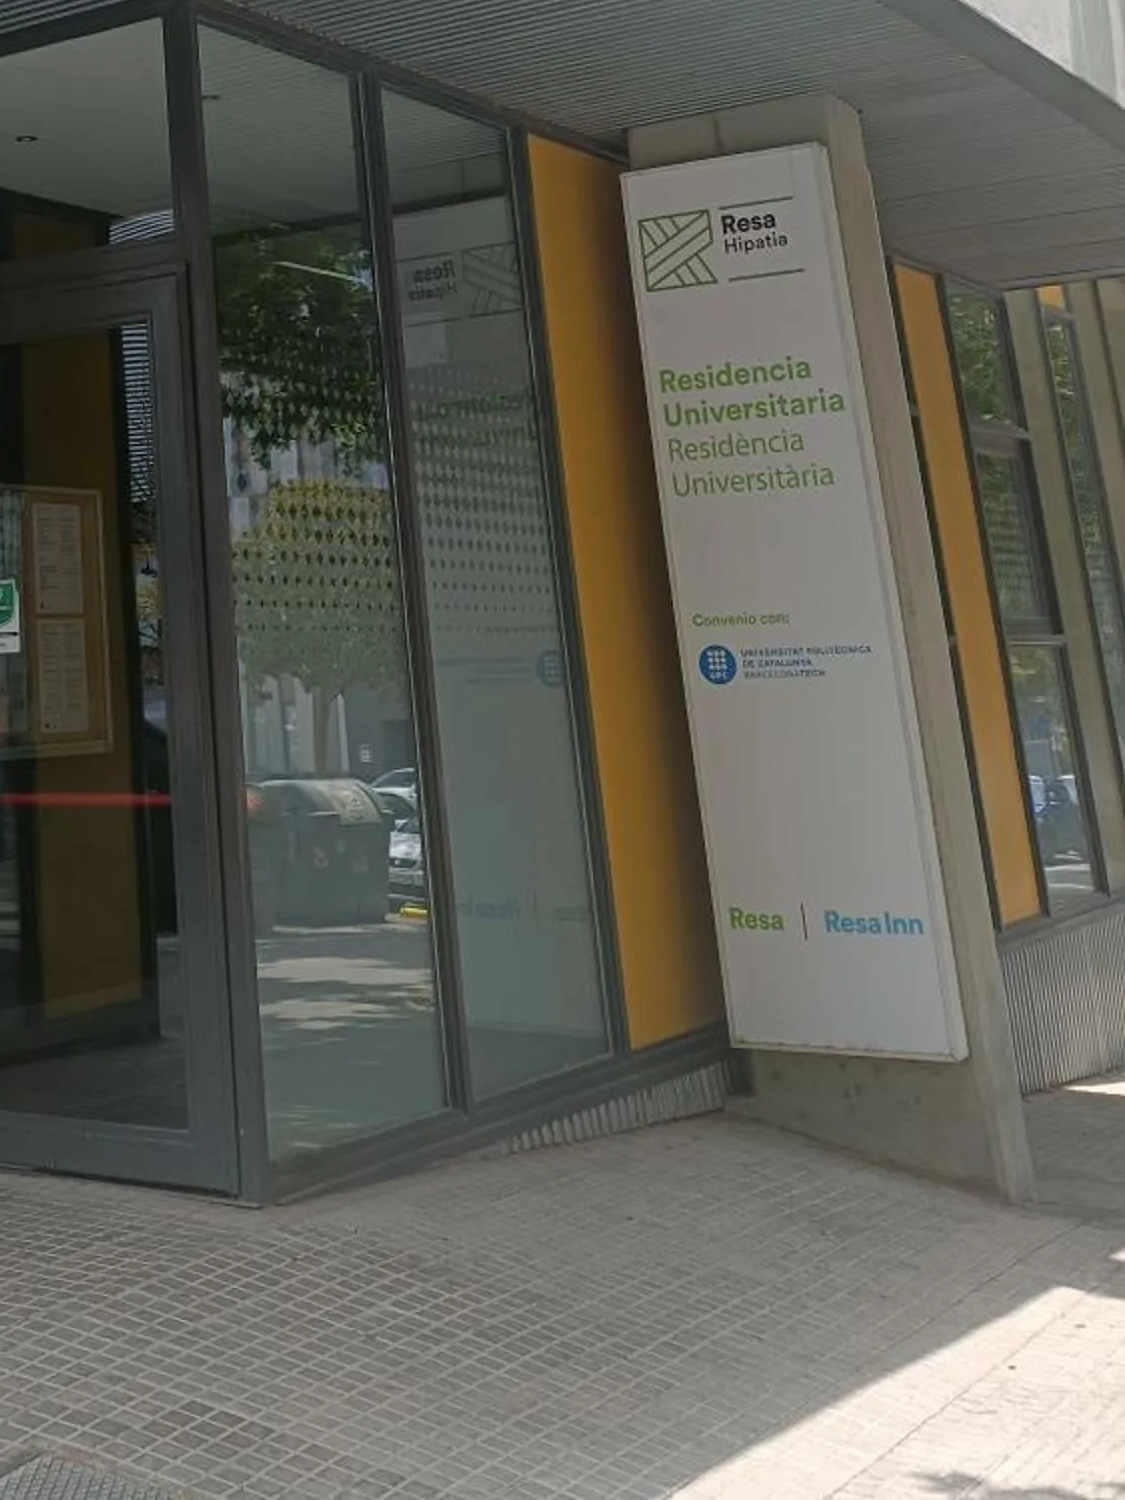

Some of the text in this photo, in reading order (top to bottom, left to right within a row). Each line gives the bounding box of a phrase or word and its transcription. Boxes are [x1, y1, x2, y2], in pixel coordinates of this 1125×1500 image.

[720, 212, 776, 235] Resa
[723, 232, 789, 255] Hipatia
[659, 356, 812, 394] Residencia
[663, 388, 845, 427] Universitaria
[667, 430, 805, 463] Residència
[671, 463, 835, 498] Universitària
[692, 611, 756, 627] Convenio
[729, 906, 785, 931] Resa
